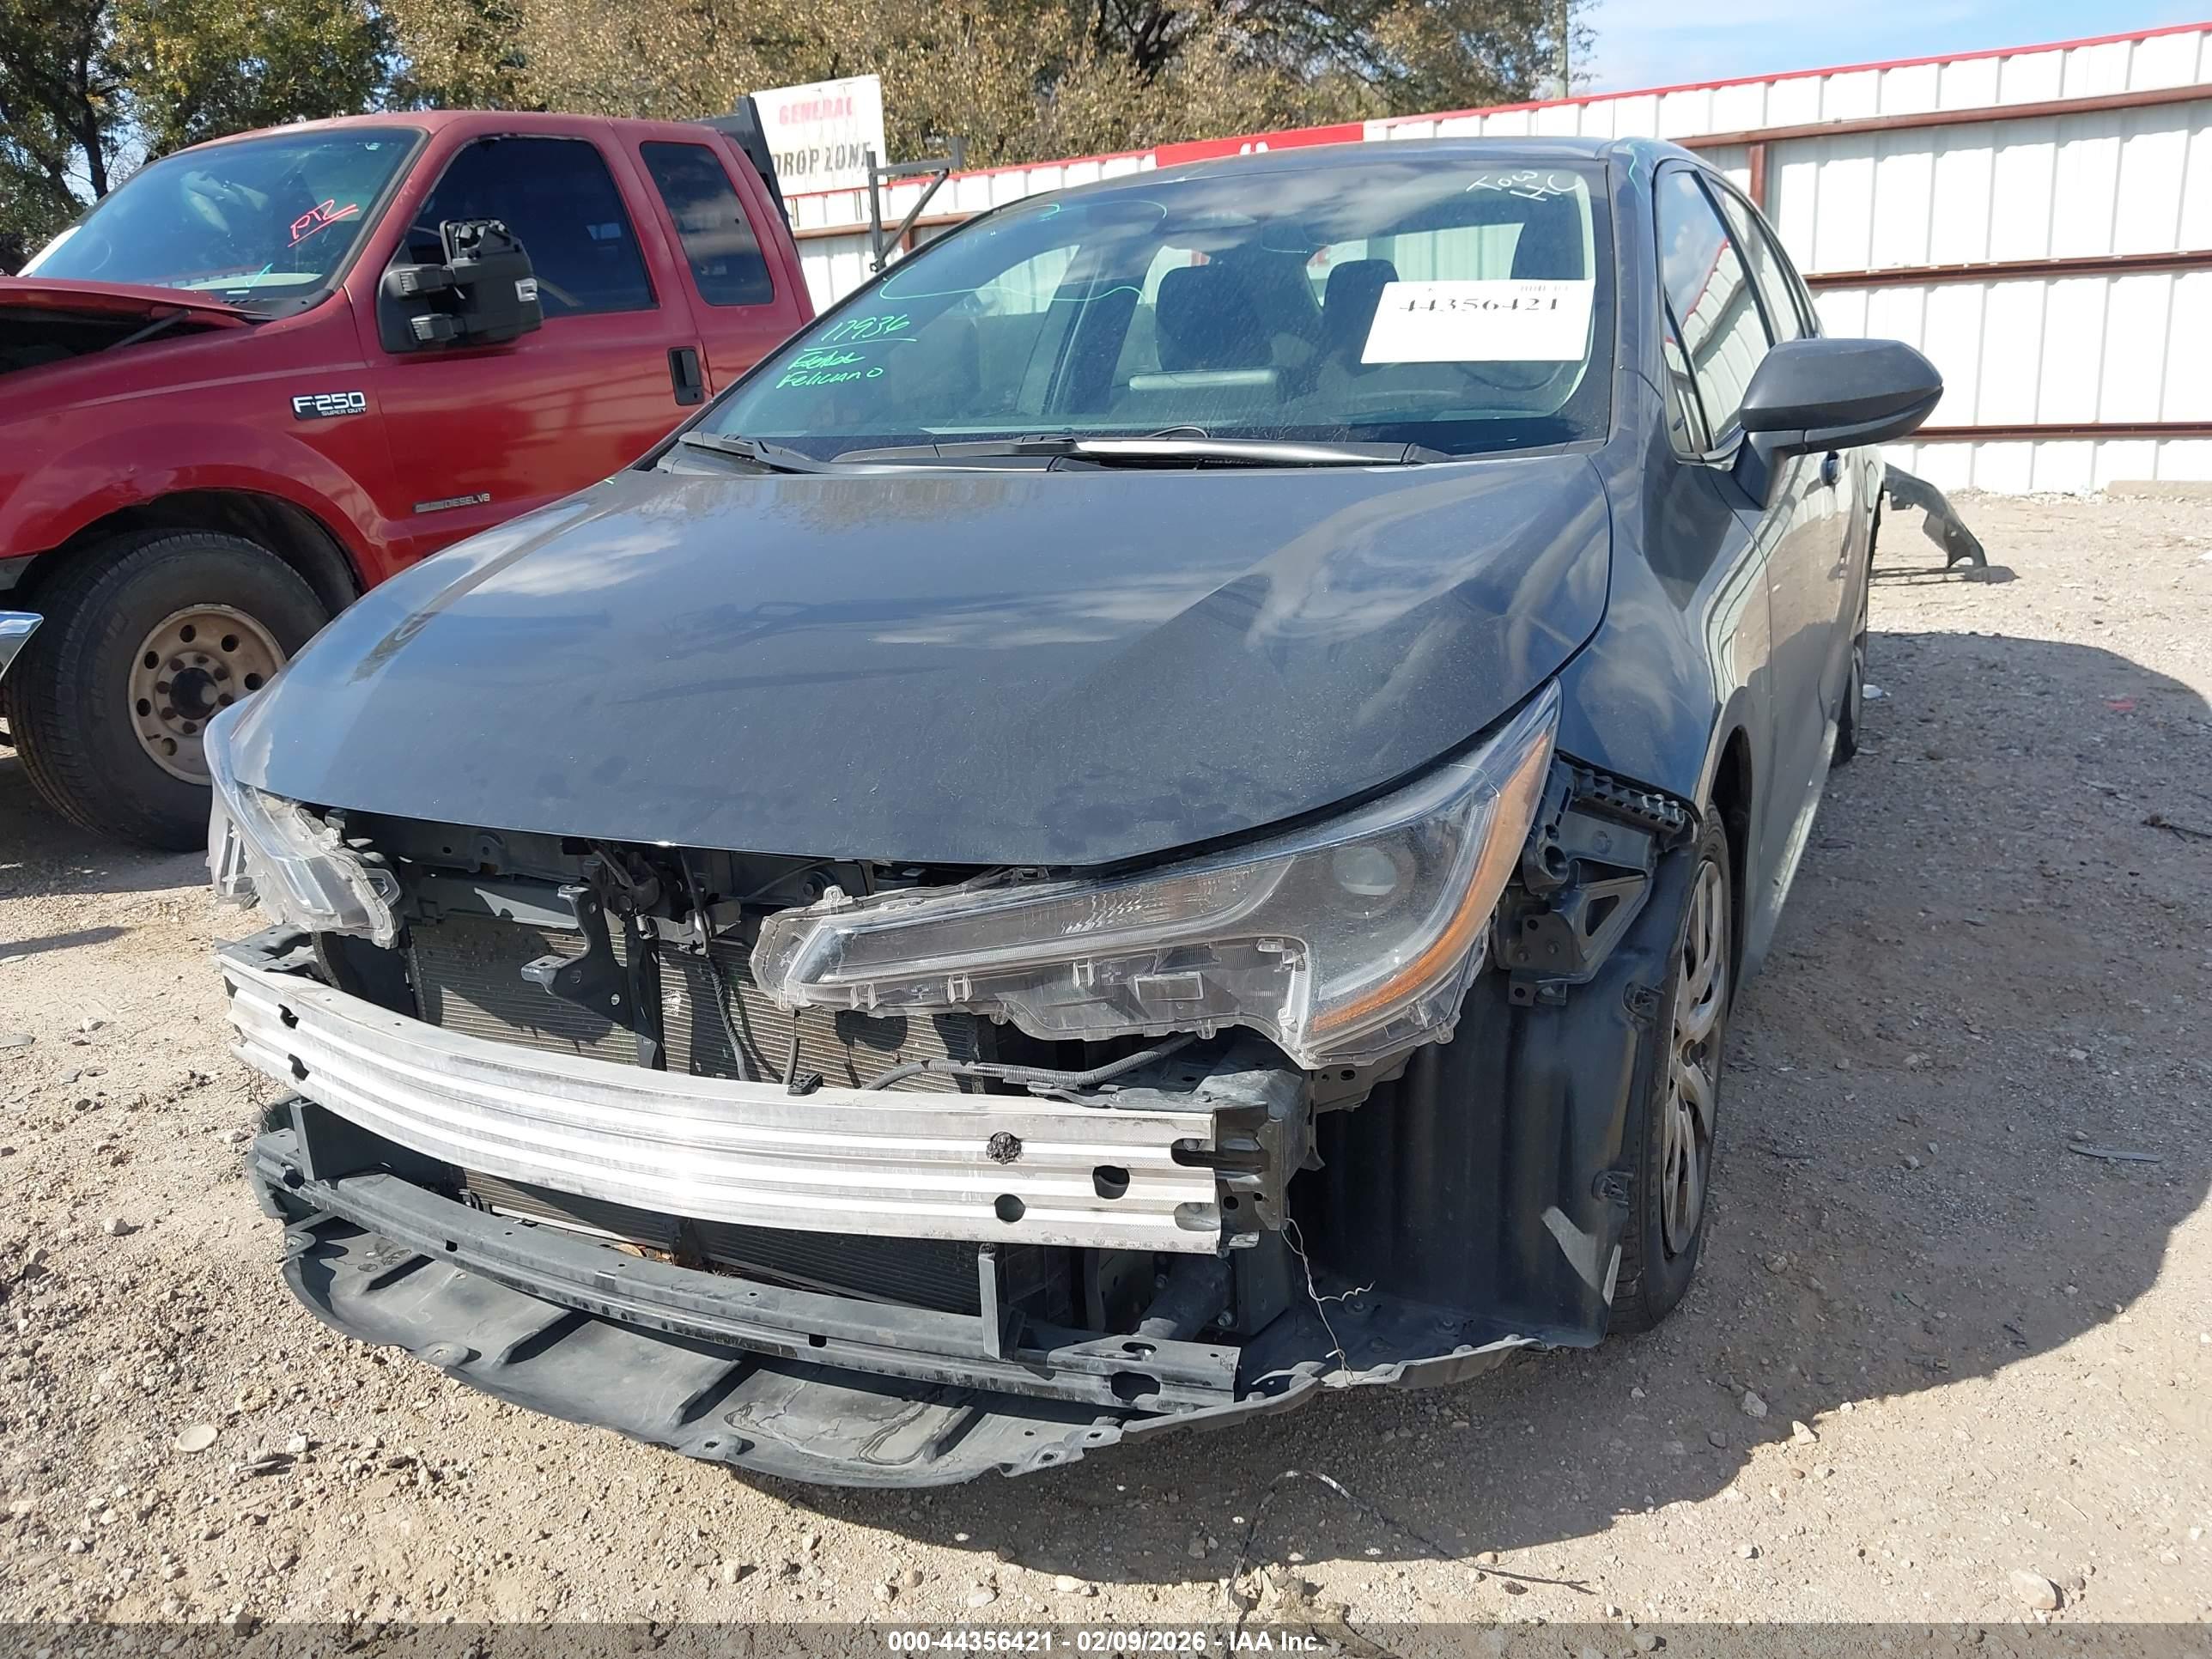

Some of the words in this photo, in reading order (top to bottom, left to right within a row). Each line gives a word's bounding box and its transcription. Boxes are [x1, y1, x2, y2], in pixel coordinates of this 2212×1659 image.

[779, 96, 853, 125] GENERAL
[772, 148, 820, 178] DROP
[1399, 298, 1558, 312] 44356421
[821, 313, 910, 342] 17936
[445, 495, 478, 508] DIESEL
[477, 493, 490, 502] V8
